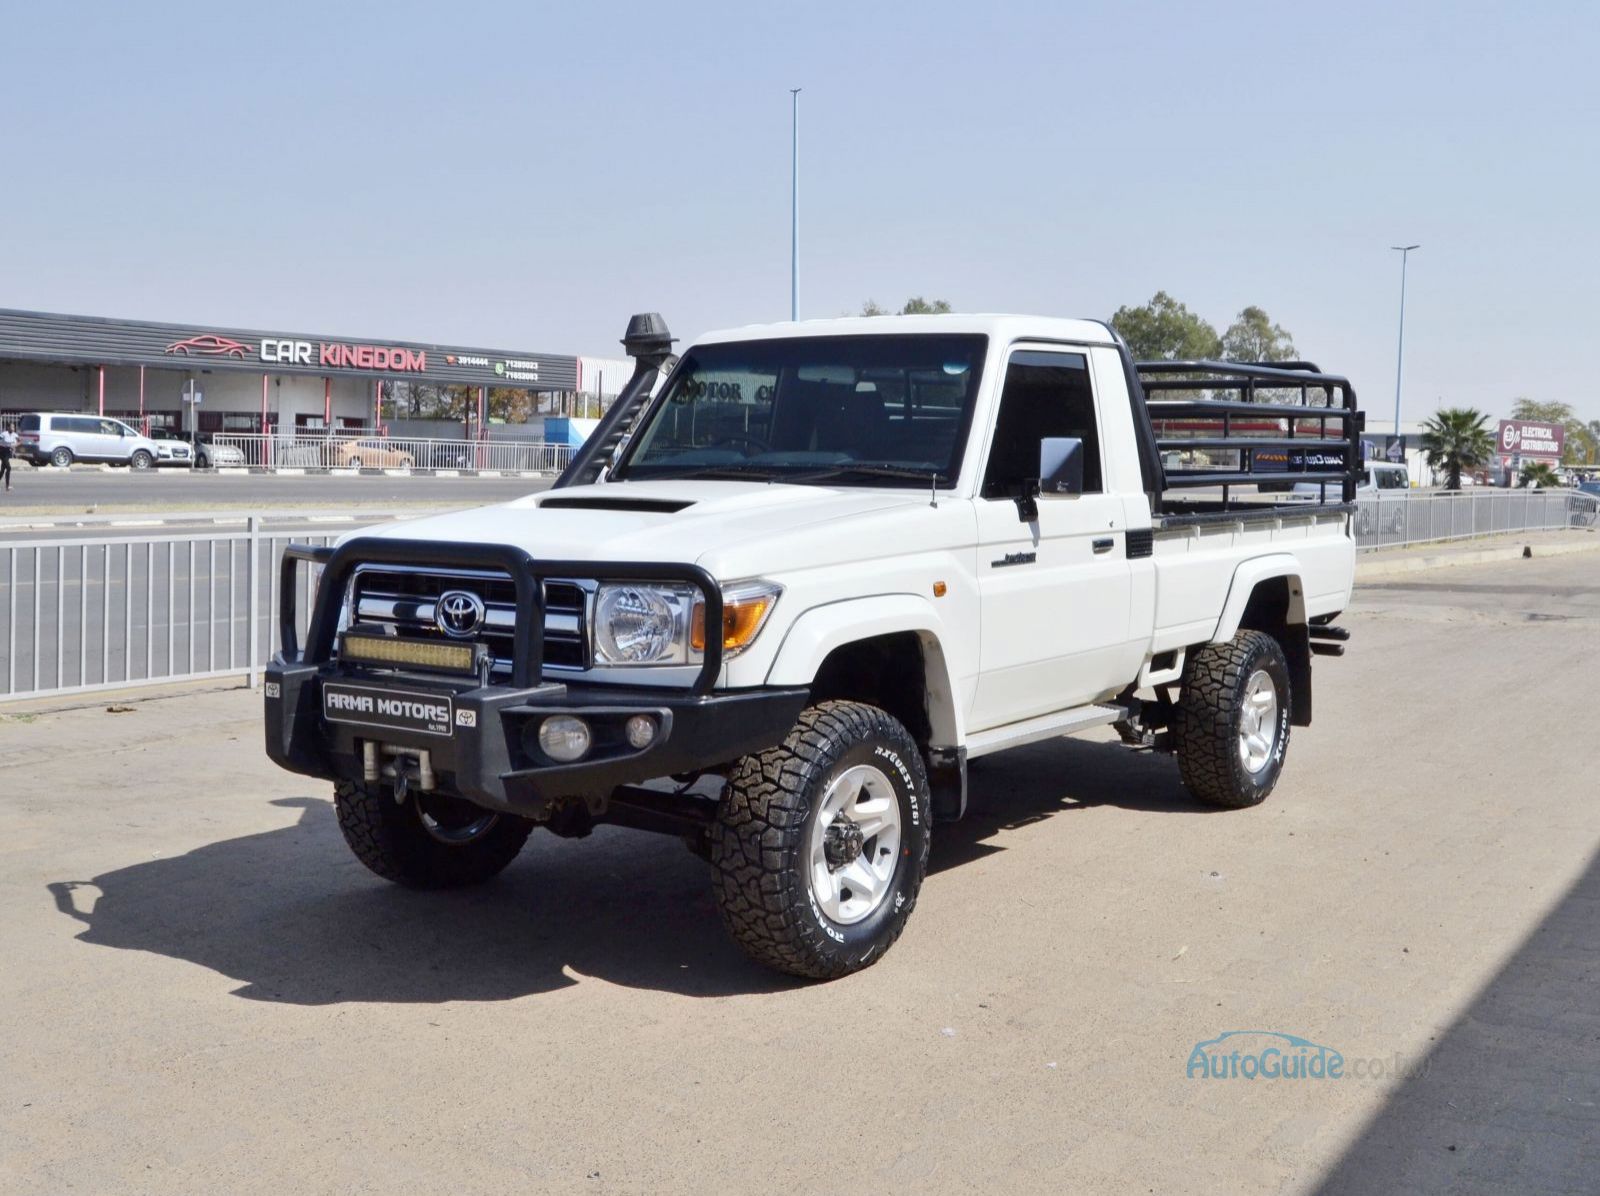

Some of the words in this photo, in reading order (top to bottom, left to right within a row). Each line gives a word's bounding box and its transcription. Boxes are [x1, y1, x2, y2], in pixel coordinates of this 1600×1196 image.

[260, 339, 312, 364] CAR
[319, 343, 427, 371] KINGDOM
[1520, 439, 1559, 452] DISTRIBUTORS
[1521, 426, 1553, 439] ELECTRICAL
[327, 693, 373, 712] ARMA
[377, 698, 449, 721] MOTORS
[1273, 707, 1288, 764] ROADX
[875, 746, 914, 790] RXQUEST
[808, 887, 844, 943] ROADX
